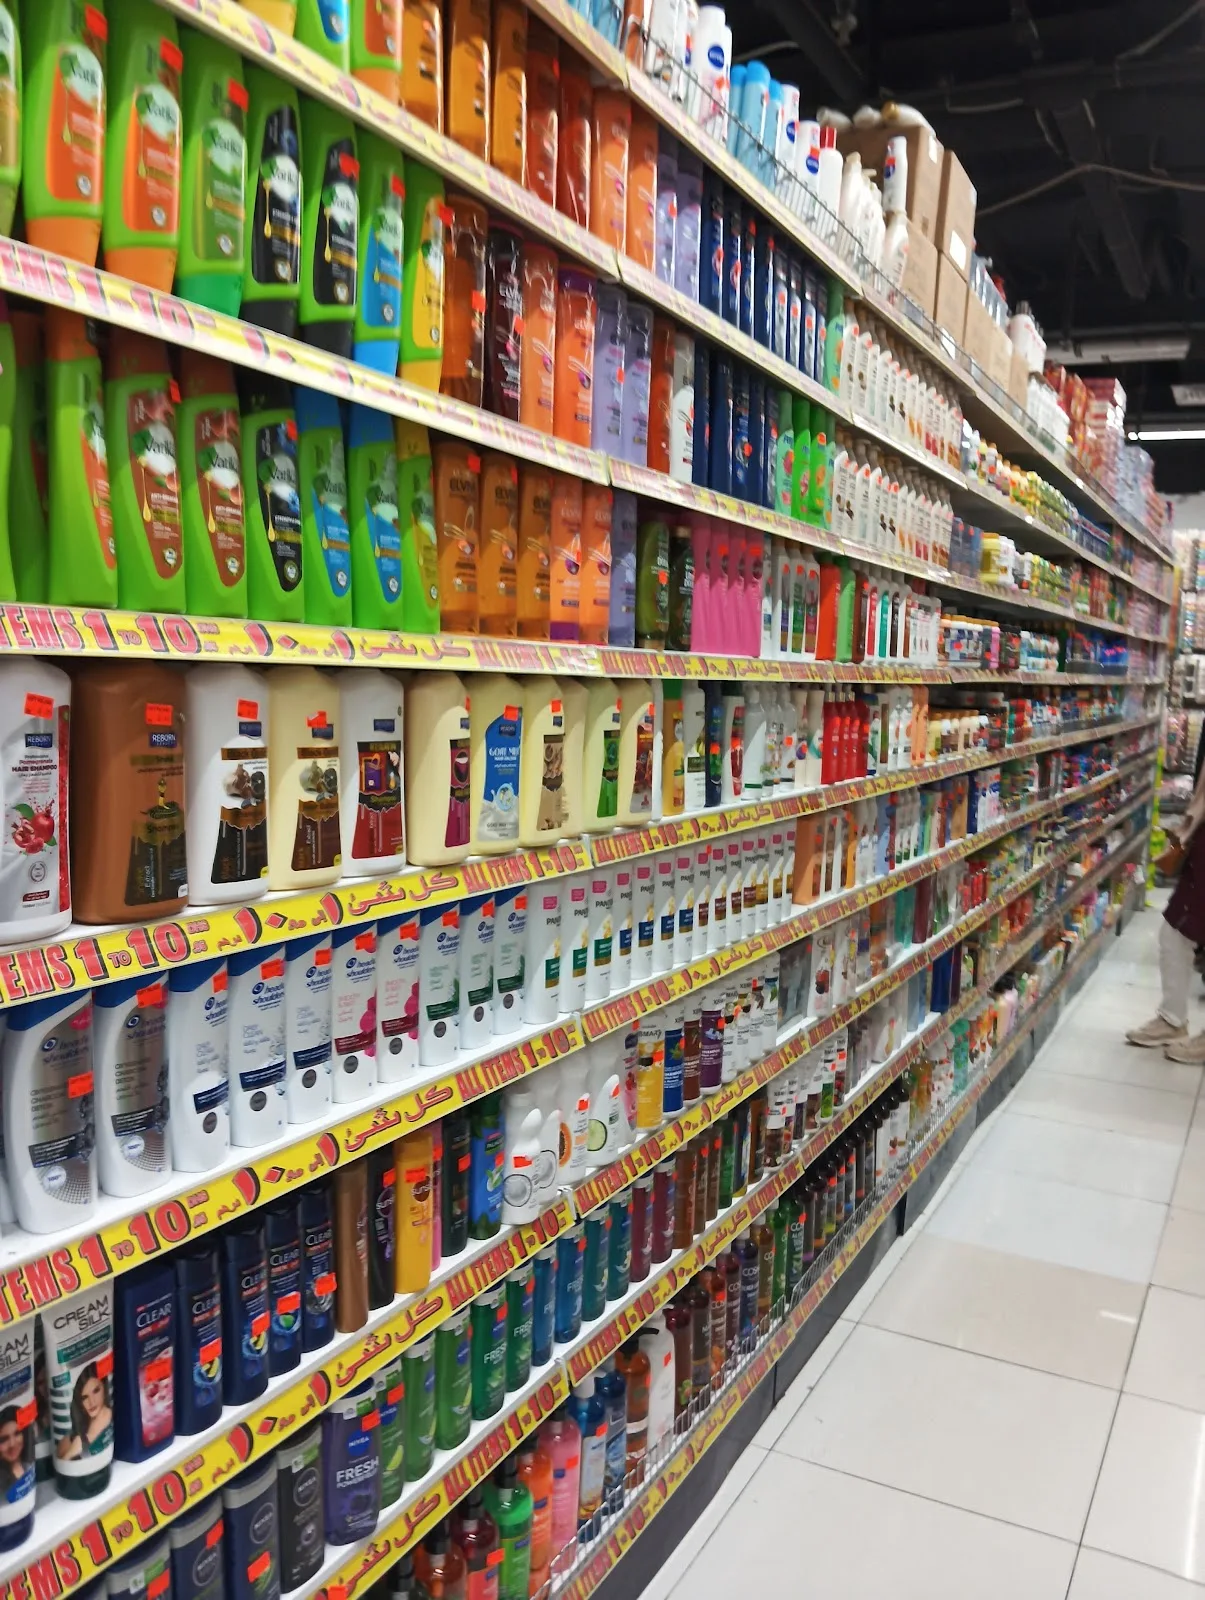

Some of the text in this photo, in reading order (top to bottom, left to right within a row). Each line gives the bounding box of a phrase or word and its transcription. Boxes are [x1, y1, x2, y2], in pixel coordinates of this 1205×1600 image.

[82, 610, 119, 651] 1
[116, 629, 143, 646] TO
[136, 613, 202, 655] 10
[420, 636, 471, 662] كل
[594, 823, 680, 864] ALL ITEMS 1 10
[408, 871, 460, 902] كل
[460, 862, 491, 895] ALL
[485, 853, 533, 889] ITEMS
[527, 850, 546, 879] 1
[547, 845, 579, 874] 10
[73, 937, 110, 982] 1
[107, 950, 133, 969] TO
[126, 922, 192, 970] 10
[584, 979, 671, 1039] ALL ITEMS 1 10
[455, 1067, 486, 1103] ALL
[480, 1046, 527, 1090] ITEMS
[520, 1040, 540, 1069] 1
[541, 1026, 572, 1059] 10
[403, 1084, 455, 1123] كل
[574, 1139, 663, 1215] ALL ITEMS 1 10
[78, 1232, 114, 1279] 1
[110, 1239, 136, 1261] TO
[128, 1199, 192, 1256] 10
[444, 1270, 476, 1310] ALL
[470, 1240, 516, 1293] ITEMS
[511, 1230, 529, 1260] 1
[531, 1208, 561, 1246] 10
[53, 1295, 109, 1330] CREAM
[78, 1305, 110, 1332] SILK
[136, 1302, 172, 1329] CLEAR
[394, 1295, 444, 1344] كل
[567, 1289, 656, 1384] ALL ITEMS 1 10
[336, 1455, 380, 1483] FRESH
[442, 1382, 556, 1507] ALL ITEMS 1 10
[80, 1518, 113, 1567] 1
[110, 1519, 134, 1544] TO
[127, 1469, 188, 1533] 10
[393, 1491, 441, 1549] كل
